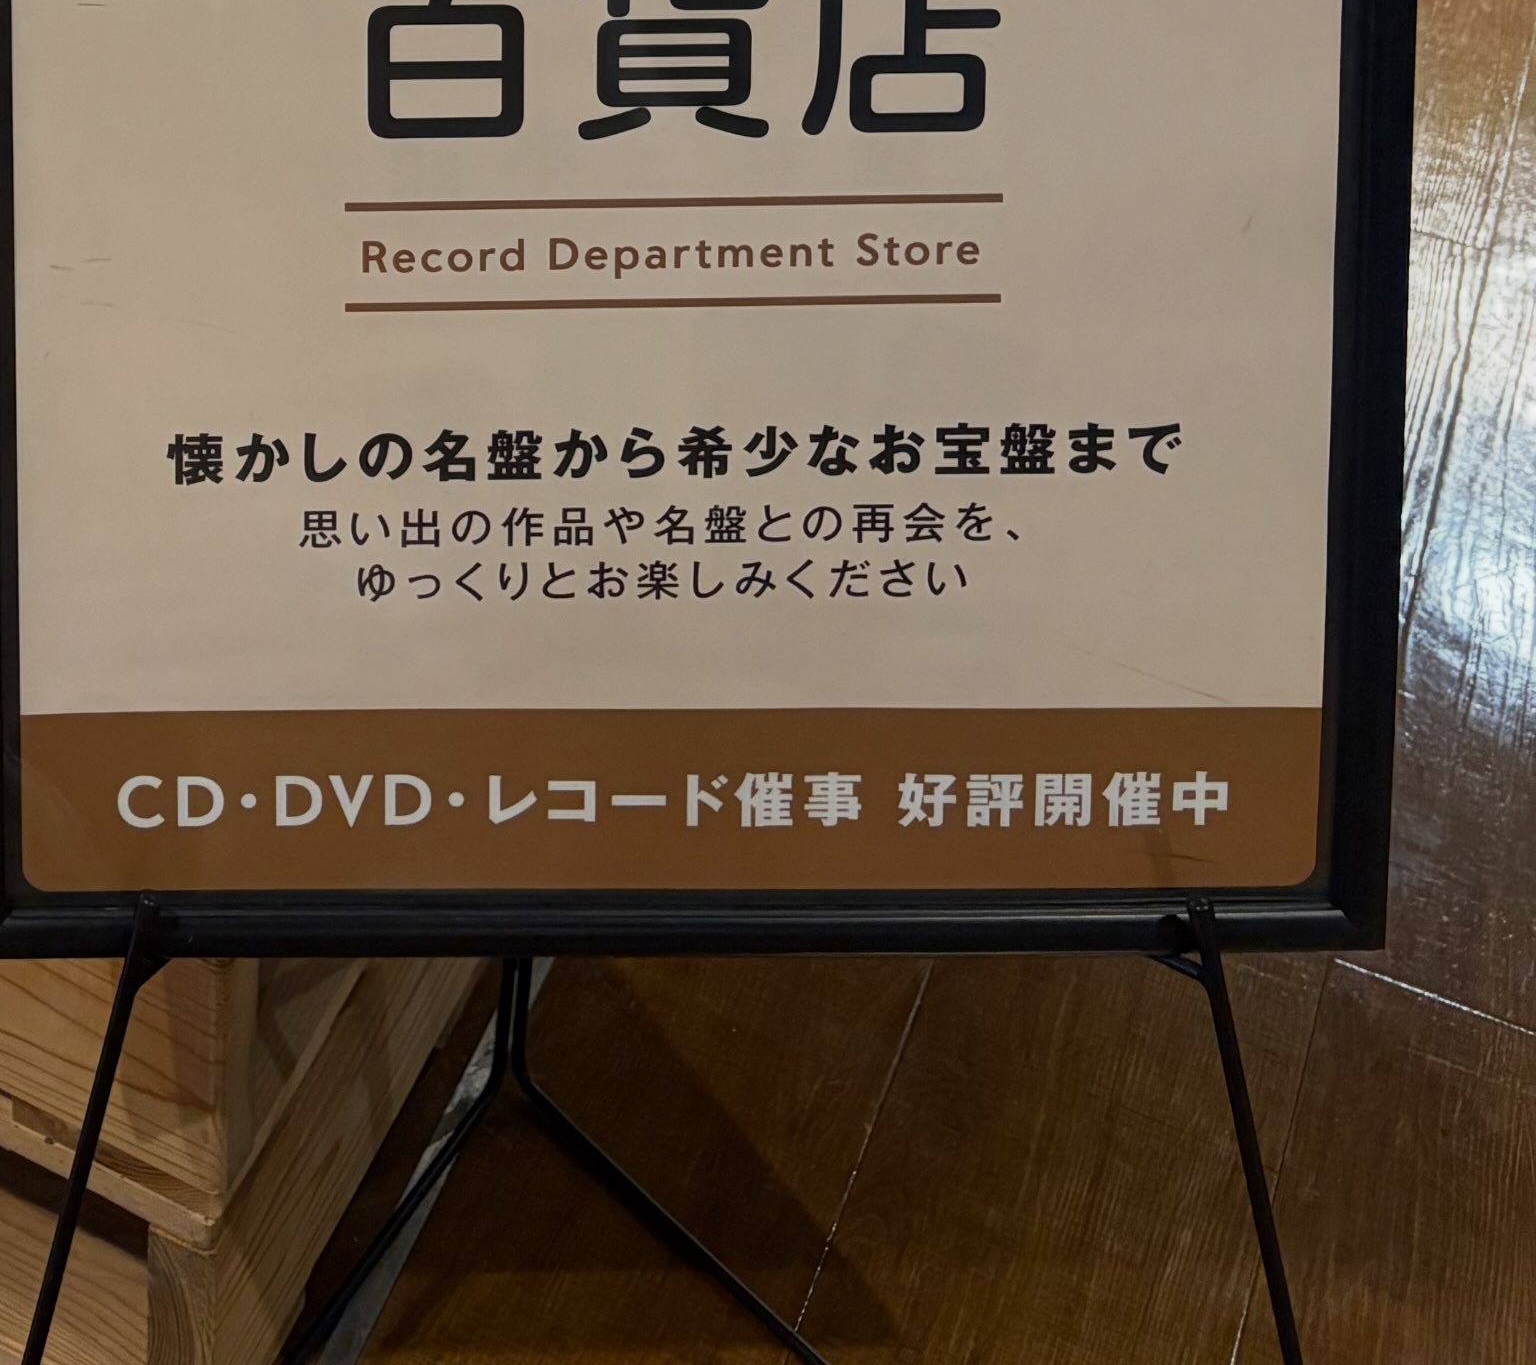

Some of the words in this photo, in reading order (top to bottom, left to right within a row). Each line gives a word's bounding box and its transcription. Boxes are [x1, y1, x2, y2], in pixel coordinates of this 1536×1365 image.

[361, 238, 526, 274] Record
[548, 236, 835, 279] Department
[855, 232, 981, 266] Store
[166, 422, 1184, 486] 懐かしの名盤から希少なお宝盤まで
[299, 502, 1024, 549] 思い出の作品や名盤との再会を、
[355, 558, 970, 602] ゆっくりとお楽しみください
[897, 770, 1232, 829] 好評開催中
